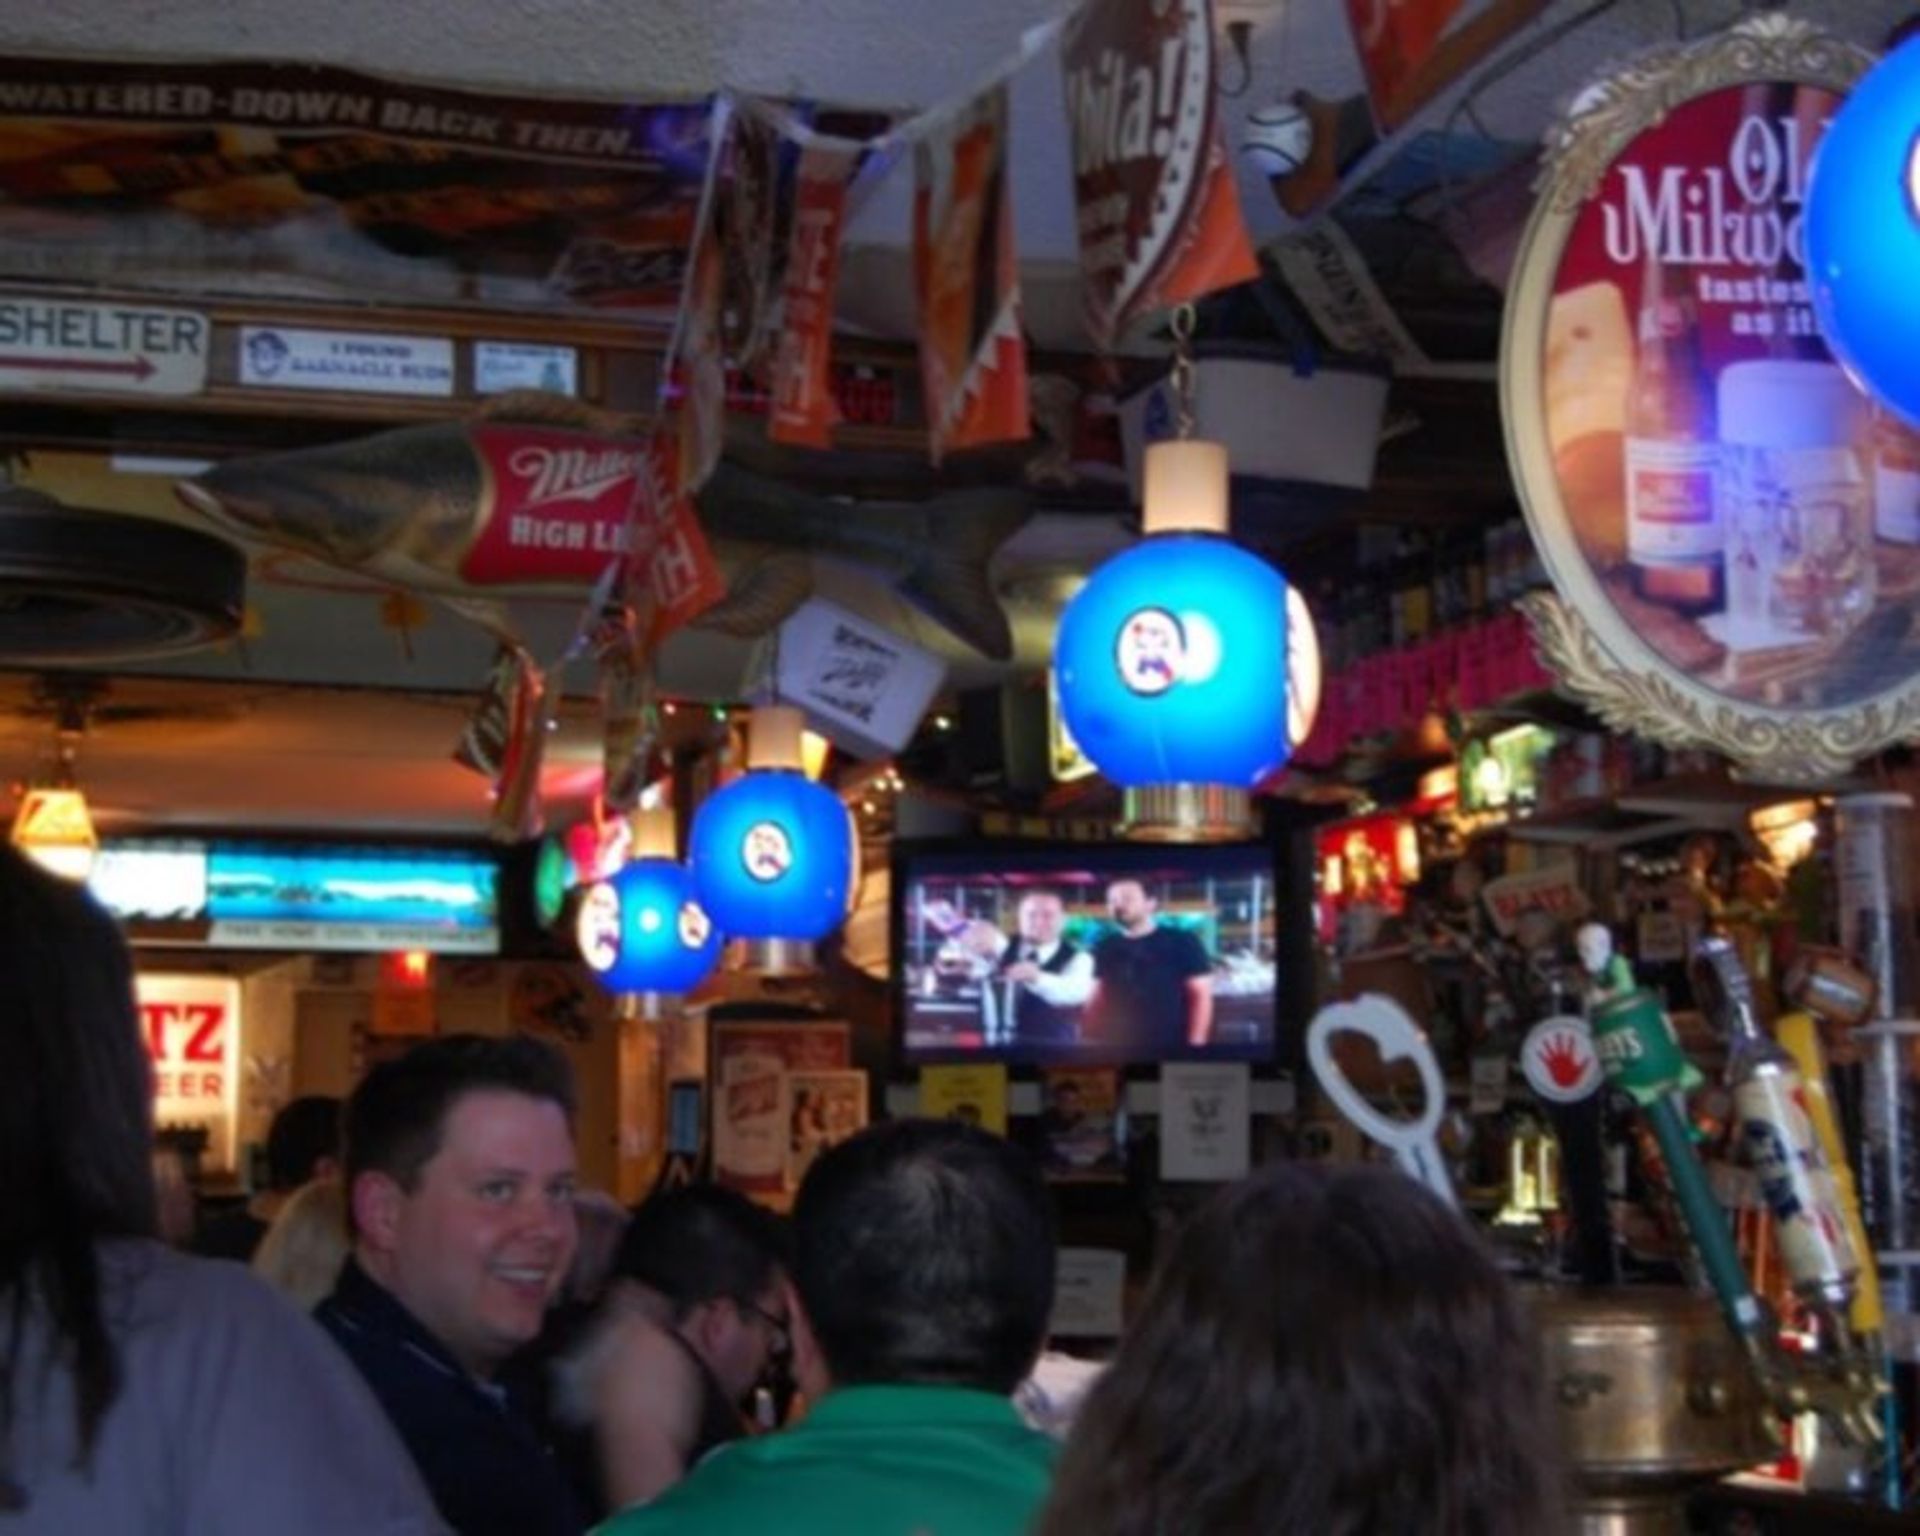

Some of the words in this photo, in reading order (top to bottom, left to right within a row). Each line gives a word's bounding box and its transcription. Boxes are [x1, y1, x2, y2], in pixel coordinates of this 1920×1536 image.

[0, 82, 371, 122] WATERED-DOWN
[379, 97, 504, 142] BACK
[1729, 115, 1806, 204] Ol
[0, 304, 200, 355] SHELTER
[508, 514, 587, 551] HIGH
